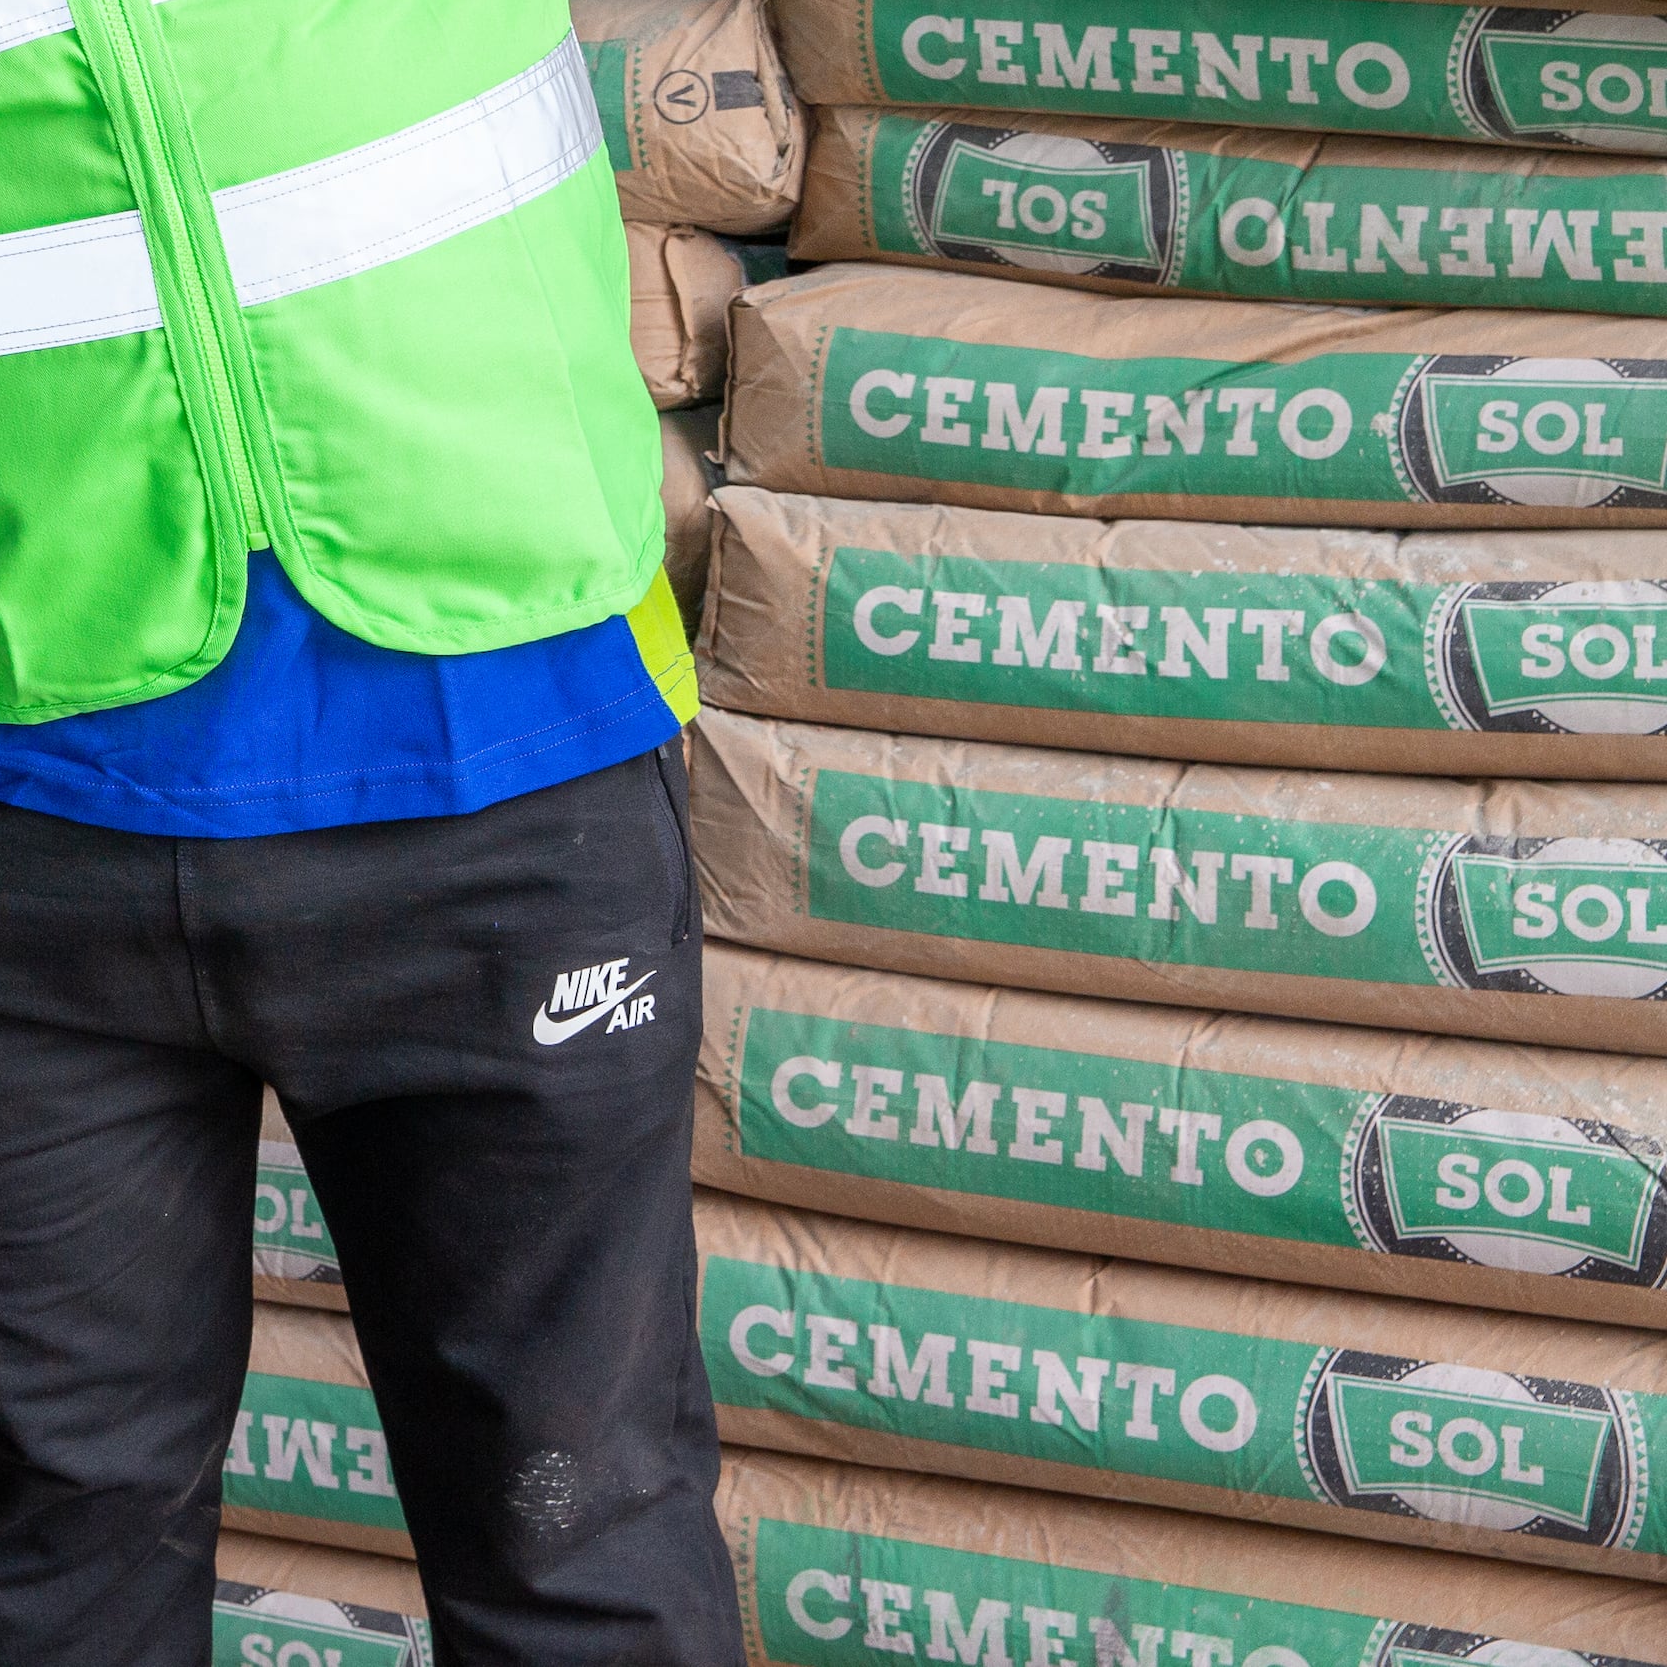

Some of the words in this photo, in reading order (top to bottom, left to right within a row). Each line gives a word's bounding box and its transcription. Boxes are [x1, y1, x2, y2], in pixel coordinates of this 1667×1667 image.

[901, 15, 1411, 111] CEMENTO
[982, 178, 1107, 240] SOL
[1219, 196, 1667, 275] EMENTO
[849, 369, 1353, 460] CEMENTO
[1477, 400, 1624, 457] SOL
[853, 585, 1387, 686] CEMENTO
[839, 815, 1376, 938] CEMENTO
[1512, 882, 1667, 946] SOL
[549, 958, 629, 1013] NIKE
[606, 994, 656, 1034] AIR
[770, 1056, 1304, 1196] CEMENTO
[1435, 1157, 1590, 1226] SOL
[253, 1186, 322, 1239] OL
[728, 1304, 1257, 1452] CEMENTO
[1388, 1411, 1544, 1486] SOL
[786, 1569, 1315, 1667] CEMENTO
